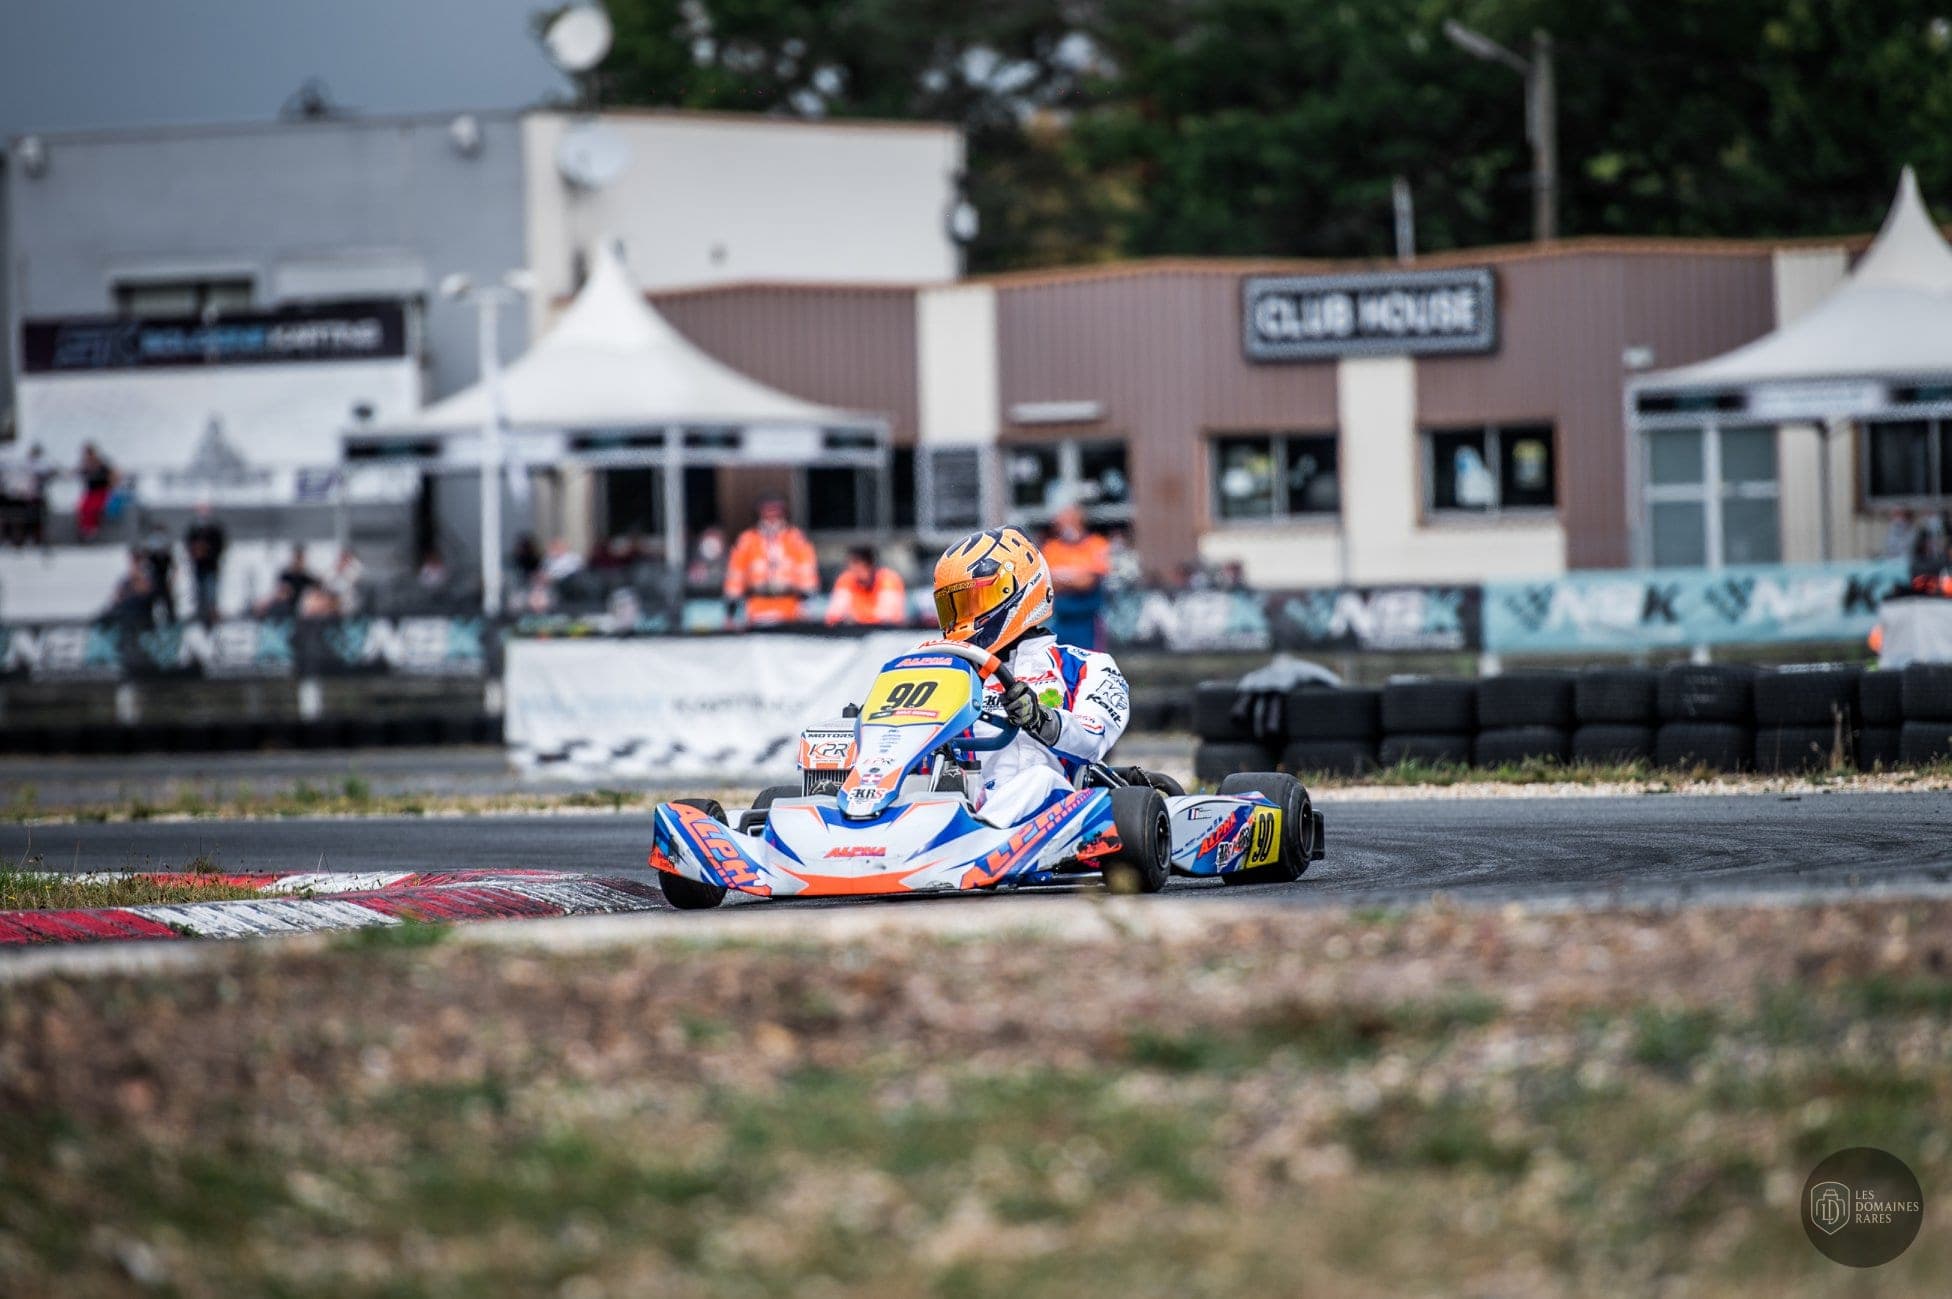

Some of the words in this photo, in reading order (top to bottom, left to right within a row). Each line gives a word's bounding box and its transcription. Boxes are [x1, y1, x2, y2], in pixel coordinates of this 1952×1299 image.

[1255, 293, 1354, 338] CLUB
[1358, 288, 1475, 332] HOUSE
[880, 681, 938, 711] 90
[1252, 812, 1275, 863] 90
